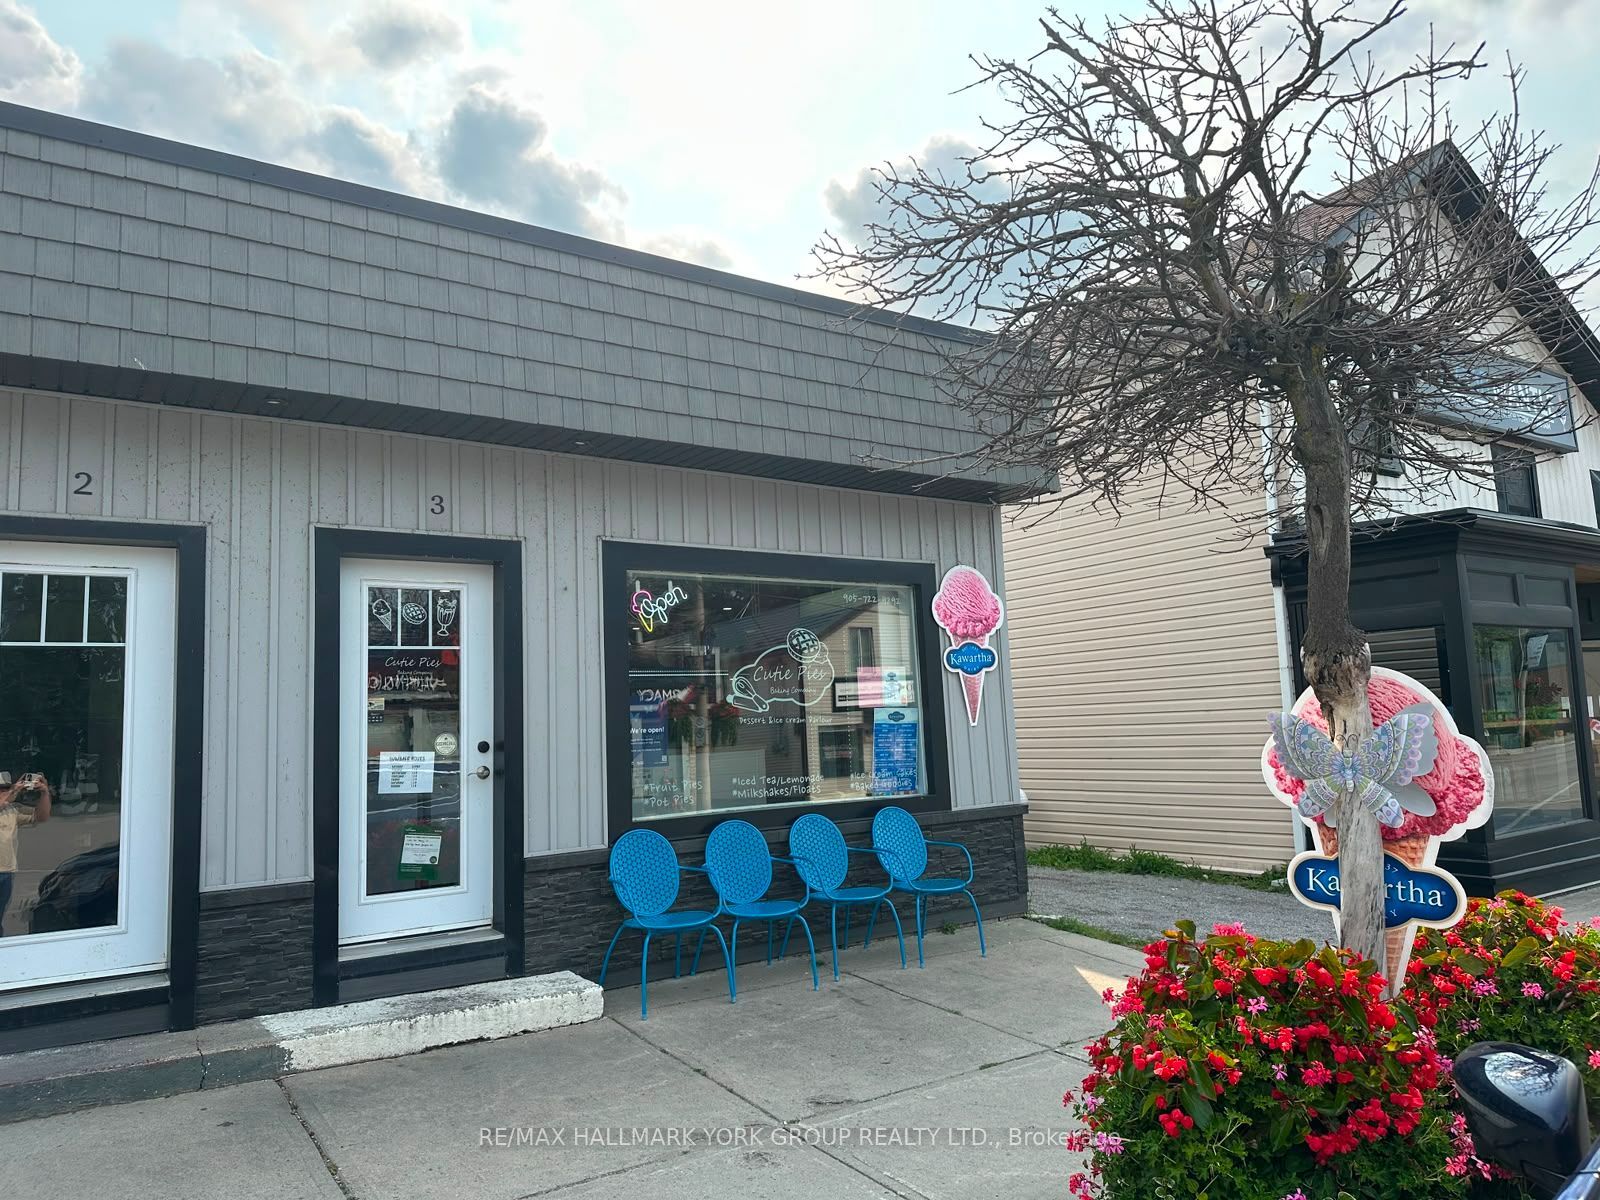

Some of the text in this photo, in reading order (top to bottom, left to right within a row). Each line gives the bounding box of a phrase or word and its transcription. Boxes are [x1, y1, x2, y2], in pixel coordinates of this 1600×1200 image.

[73, 472, 93, 495] 2
[430, 495, 445, 515] 3
[640, 586, 688, 624] Open
[385, 656, 442, 668] Cutie Pies
[950, 653, 993, 665] Kawartha
[753, 665, 827, 681] Cutie Pies
[739, 717, 766, 725] Dessert
[682, 780, 703, 790] Pies
[760, 772, 824, 786] Tea/Lemonade
[673, 794, 694, 804] Pies
[1306, 867, 1443, 907] Kartha
